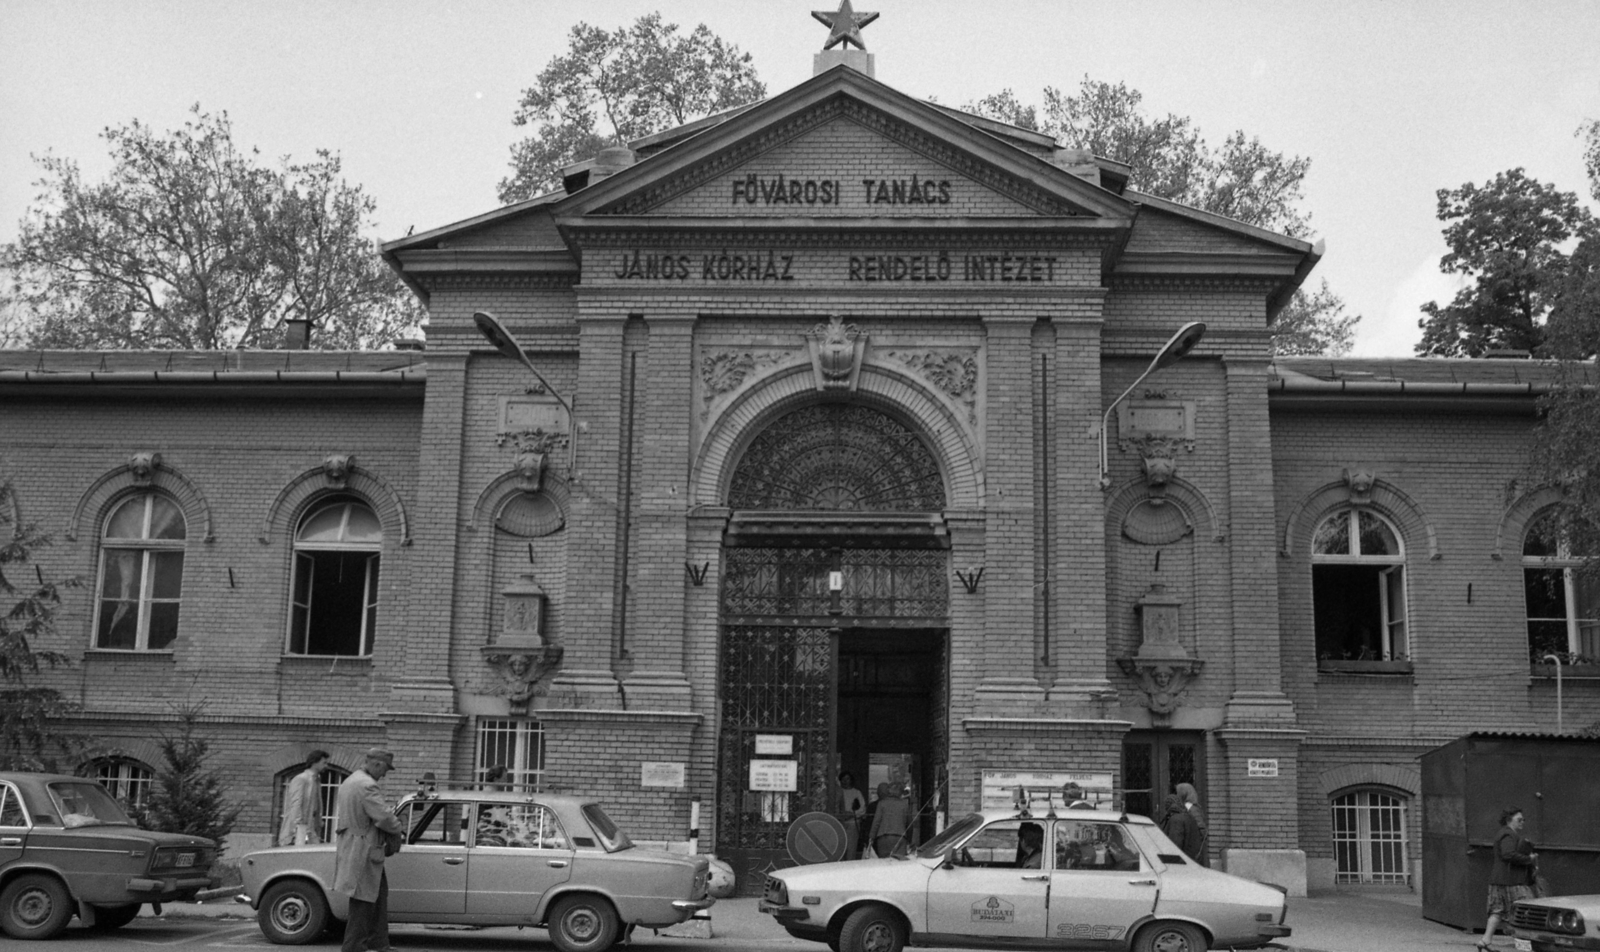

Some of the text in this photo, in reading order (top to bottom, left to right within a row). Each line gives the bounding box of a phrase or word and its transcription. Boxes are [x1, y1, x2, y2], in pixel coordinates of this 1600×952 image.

[732, 173, 951, 205] FŐVÁROSI TANÁCS
[614, 248, 1057, 281] JÁNOS KÓRHÁZ RENDELŐ INTÉZET
[1057, 923, 1126, 940] 3267
